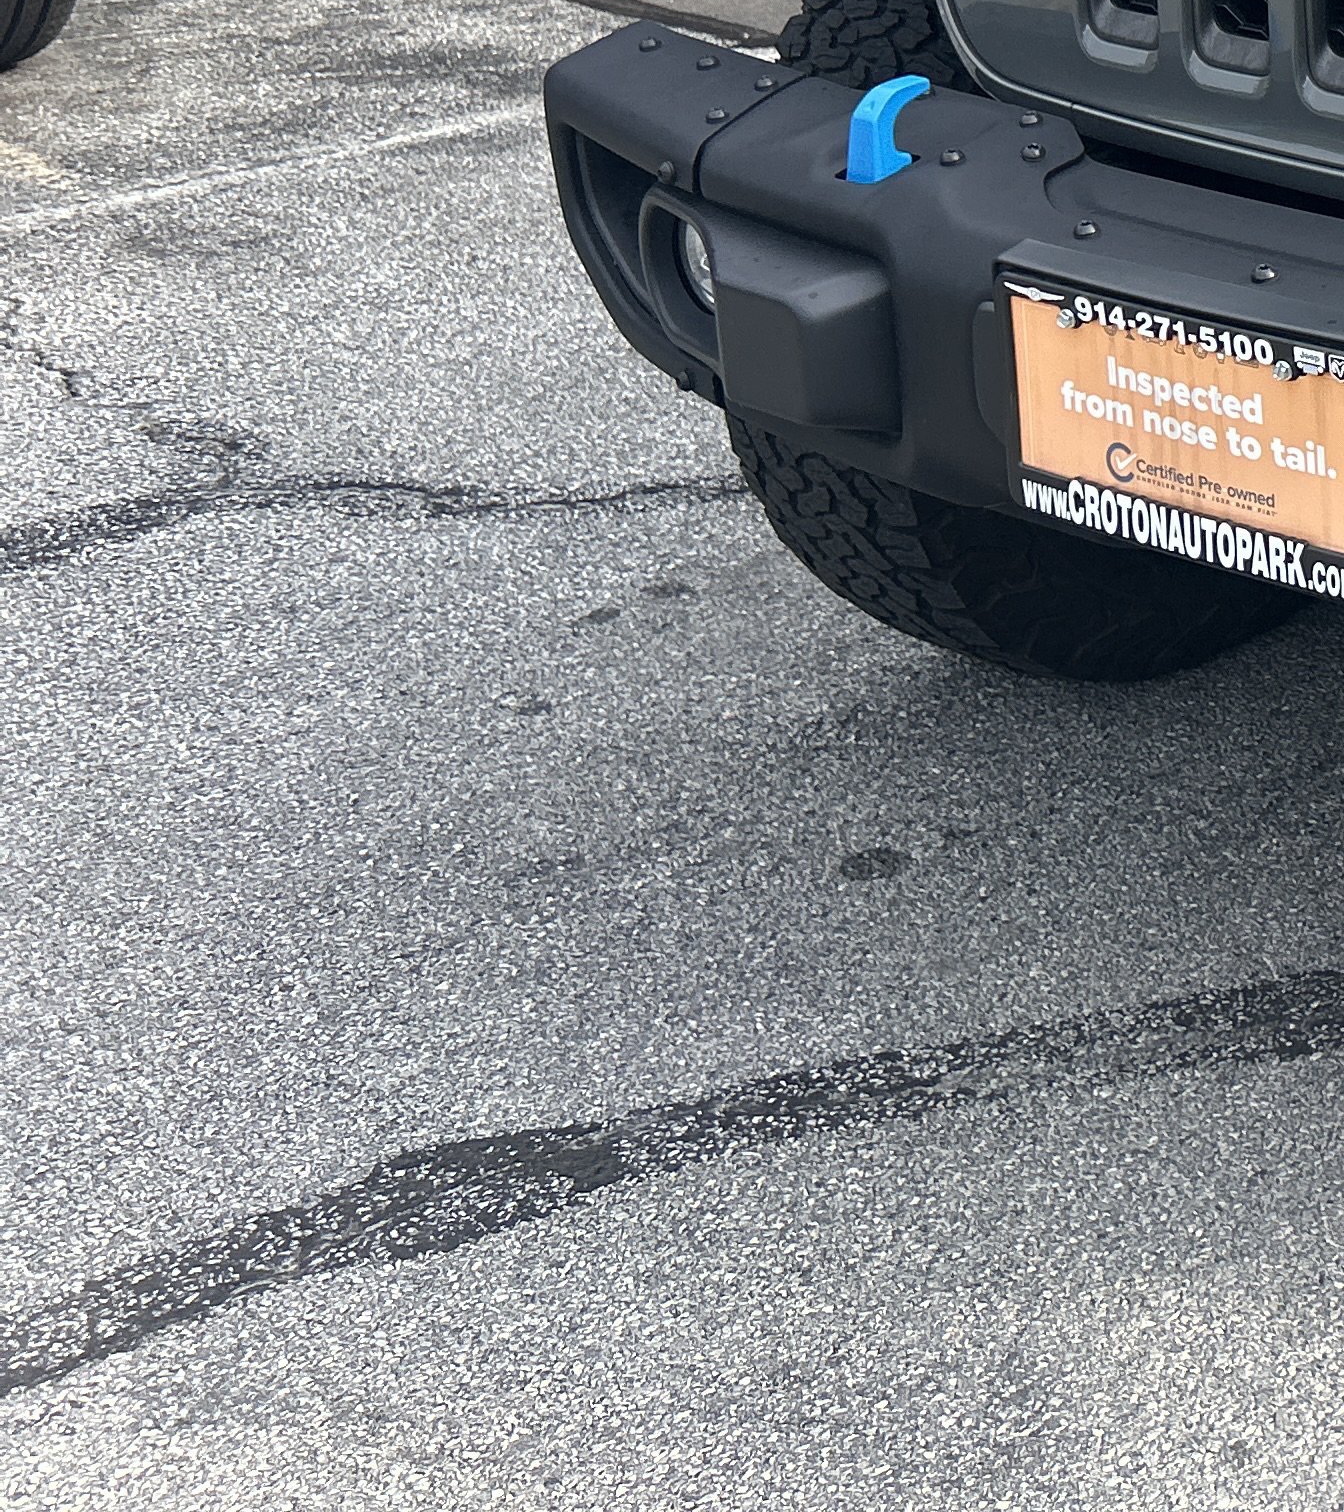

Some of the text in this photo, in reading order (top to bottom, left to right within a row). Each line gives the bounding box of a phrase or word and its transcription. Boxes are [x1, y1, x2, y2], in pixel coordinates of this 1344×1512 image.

[1074, 297, 1272, 365] 914-271-5100
[1107, 356, 1263, 424] Inspected
[1060, 382, 1337, 478] from nose to tail.
[1136, 459, 1276, 508] Certified Pre owned
